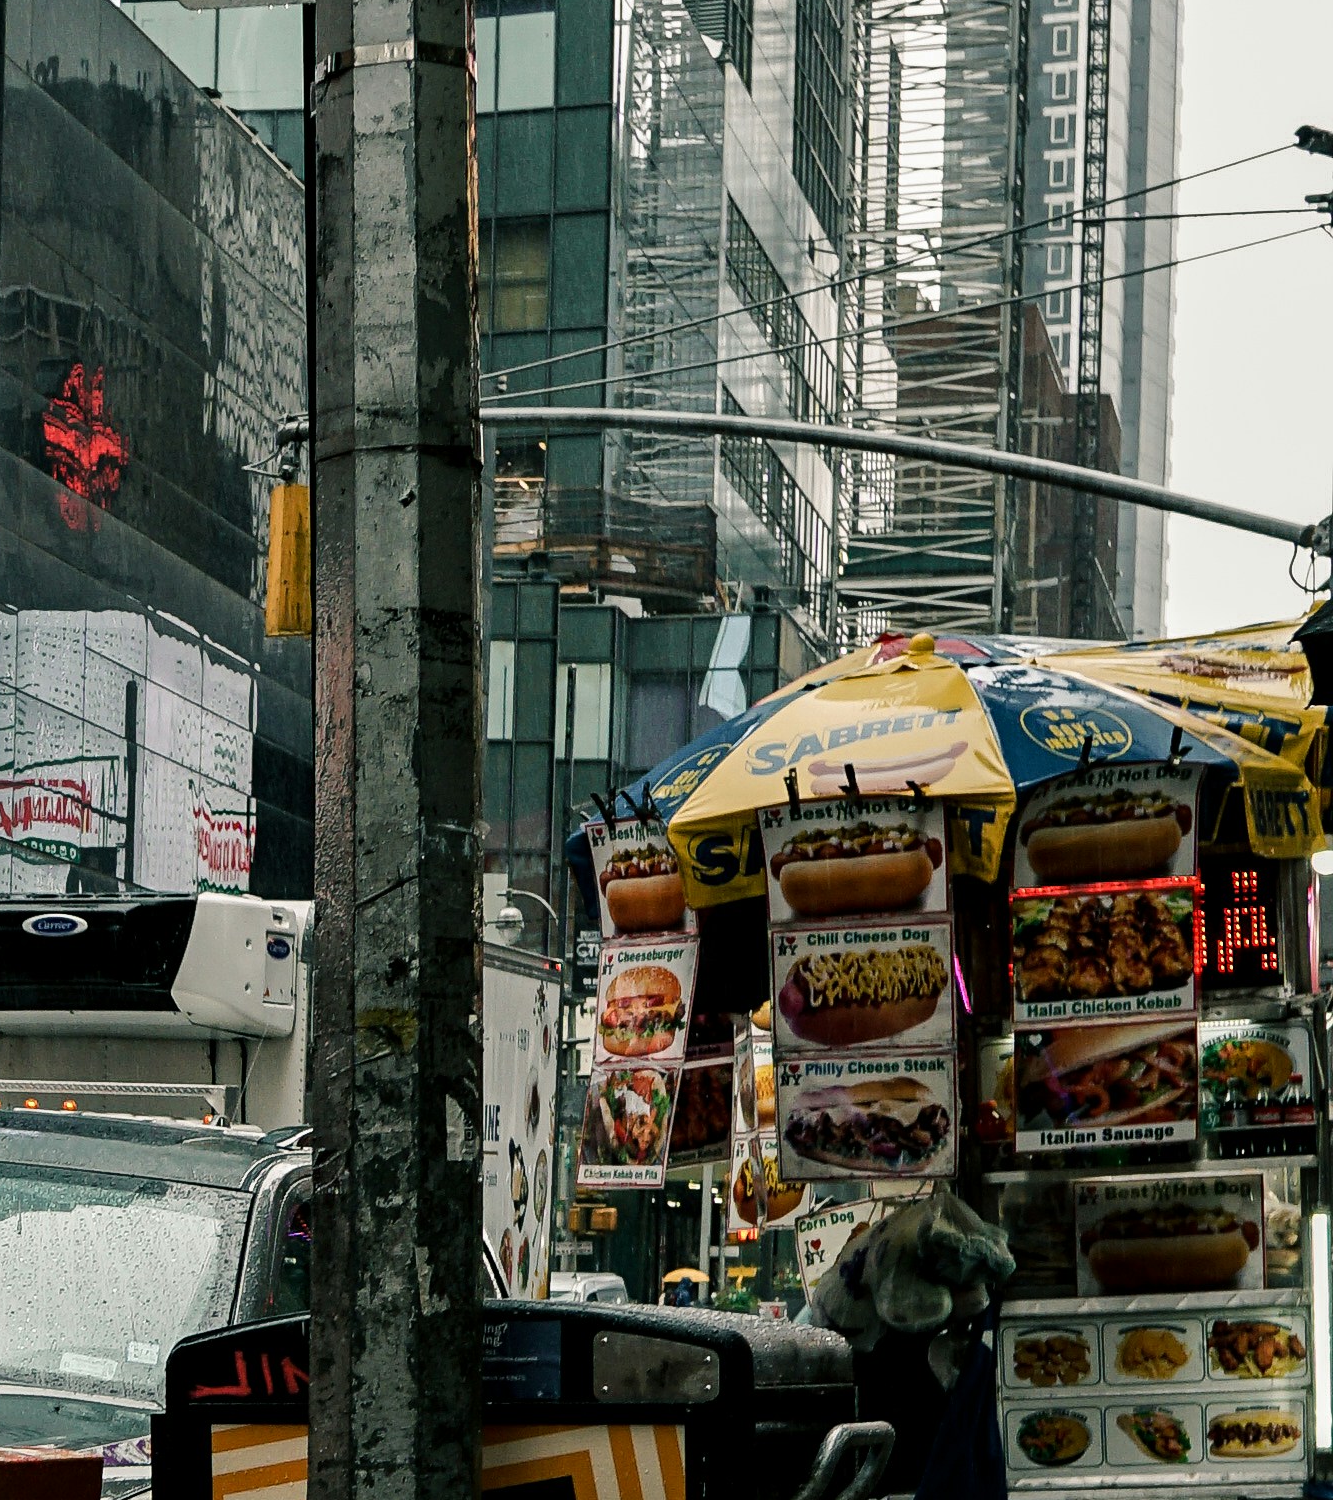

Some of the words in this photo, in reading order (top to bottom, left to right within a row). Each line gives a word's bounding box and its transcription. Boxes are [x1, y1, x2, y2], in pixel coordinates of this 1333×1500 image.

[745, 708, 962, 776] SABRETT
[789, 804, 833, 821] Best
[37, 919, 72, 930] Carrier
[807, 932, 839, 946] Chili
[843, 930, 897, 944] Cheese
[902, 928, 931, 943] Dog
[617, 948, 685, 963] Cheeseburger
[1027, 1003, 1067, 1018] Halal
[1072, 999, 1132, 1015] Chicken
[1136, 995, 1182, 1010] Kebab
[805, 1062, 844, 1077] Philly
[848, 1060, 900, 1074] Cheese
[904, 1058, 946, 1073] Steak
[1040, 1129, 1097, 1146] Italian
[1102, 1125, 1175, 1142] Sausage
[583, 1167, 612, 1179] Chicken
[612, 1167, 633, 1179] Kebab
[634, 1169, 643, 1179] on
[644, 1168, 658, 1180] Pita
[1105, 1183, 1148, 1198] Best
[1174, 1181, 1209, 1197] Hot
[1213, 1180, 1251, 1197] Dog
[798, 1215, 827, 1233] Corn
[830, 1209, 856, 1225] Dog
